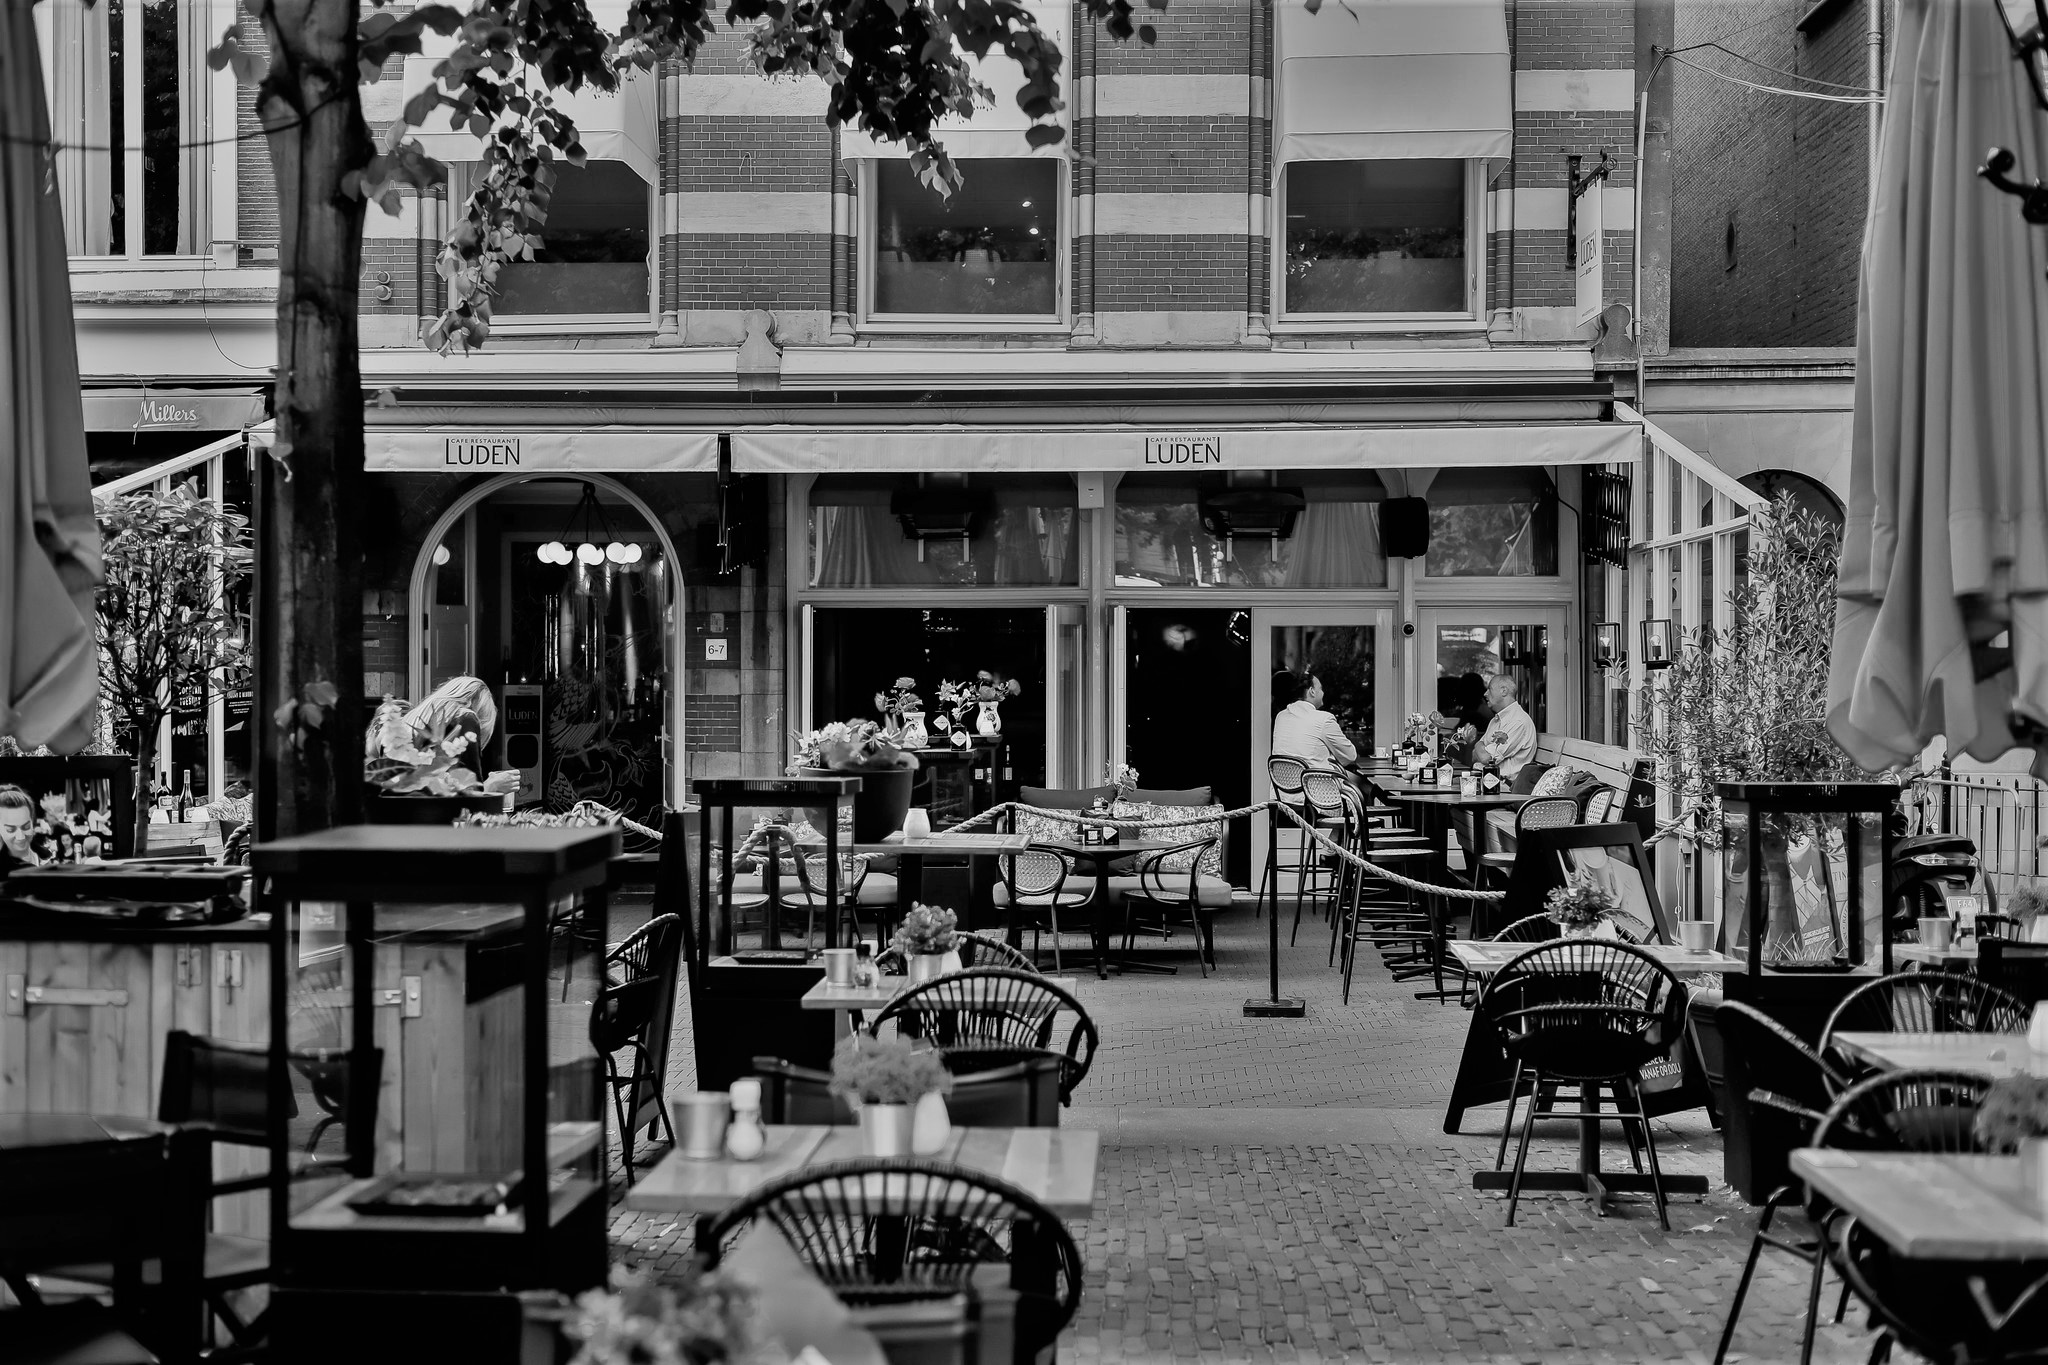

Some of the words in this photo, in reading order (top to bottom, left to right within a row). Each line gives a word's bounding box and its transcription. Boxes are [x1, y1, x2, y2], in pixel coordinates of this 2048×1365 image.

[140, 400, 197, 423] Millers
[445, 438, 520, 465] LUDEN
[1145, 437, 1220, 464] LUDEN
[708, 644, 725, 655] 6-7
[1639, 1065, 1660, 1080] VANAF
